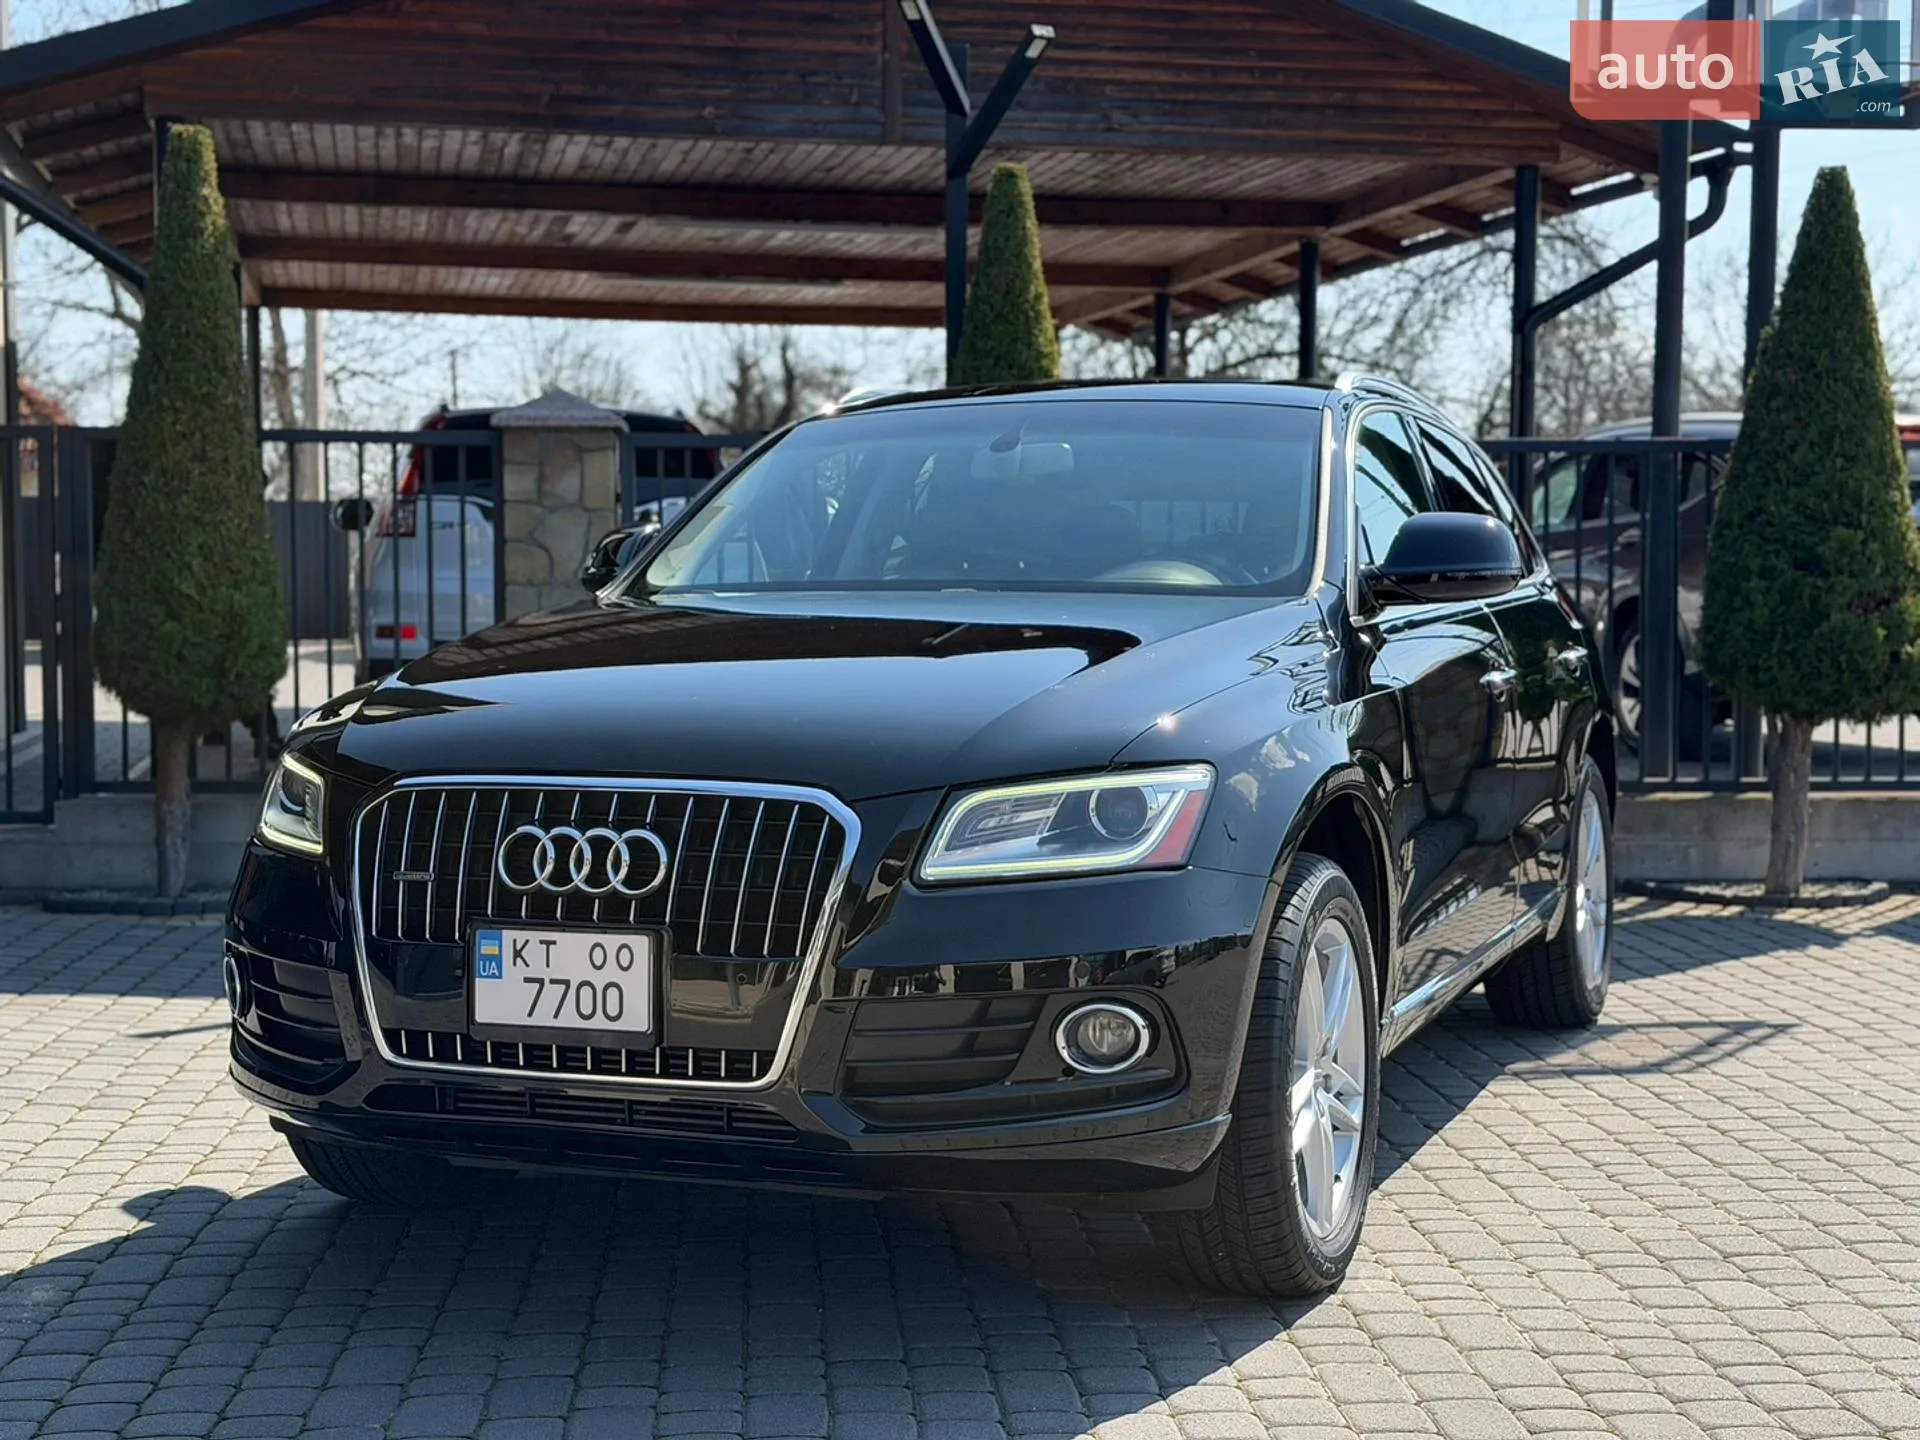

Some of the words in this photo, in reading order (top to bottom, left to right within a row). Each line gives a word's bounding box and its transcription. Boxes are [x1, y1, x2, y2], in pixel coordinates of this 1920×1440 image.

[512, 938, 557, 968] KT
[480, 961, 499, 976] UA
[523, 976, 624, 1022] 7700
